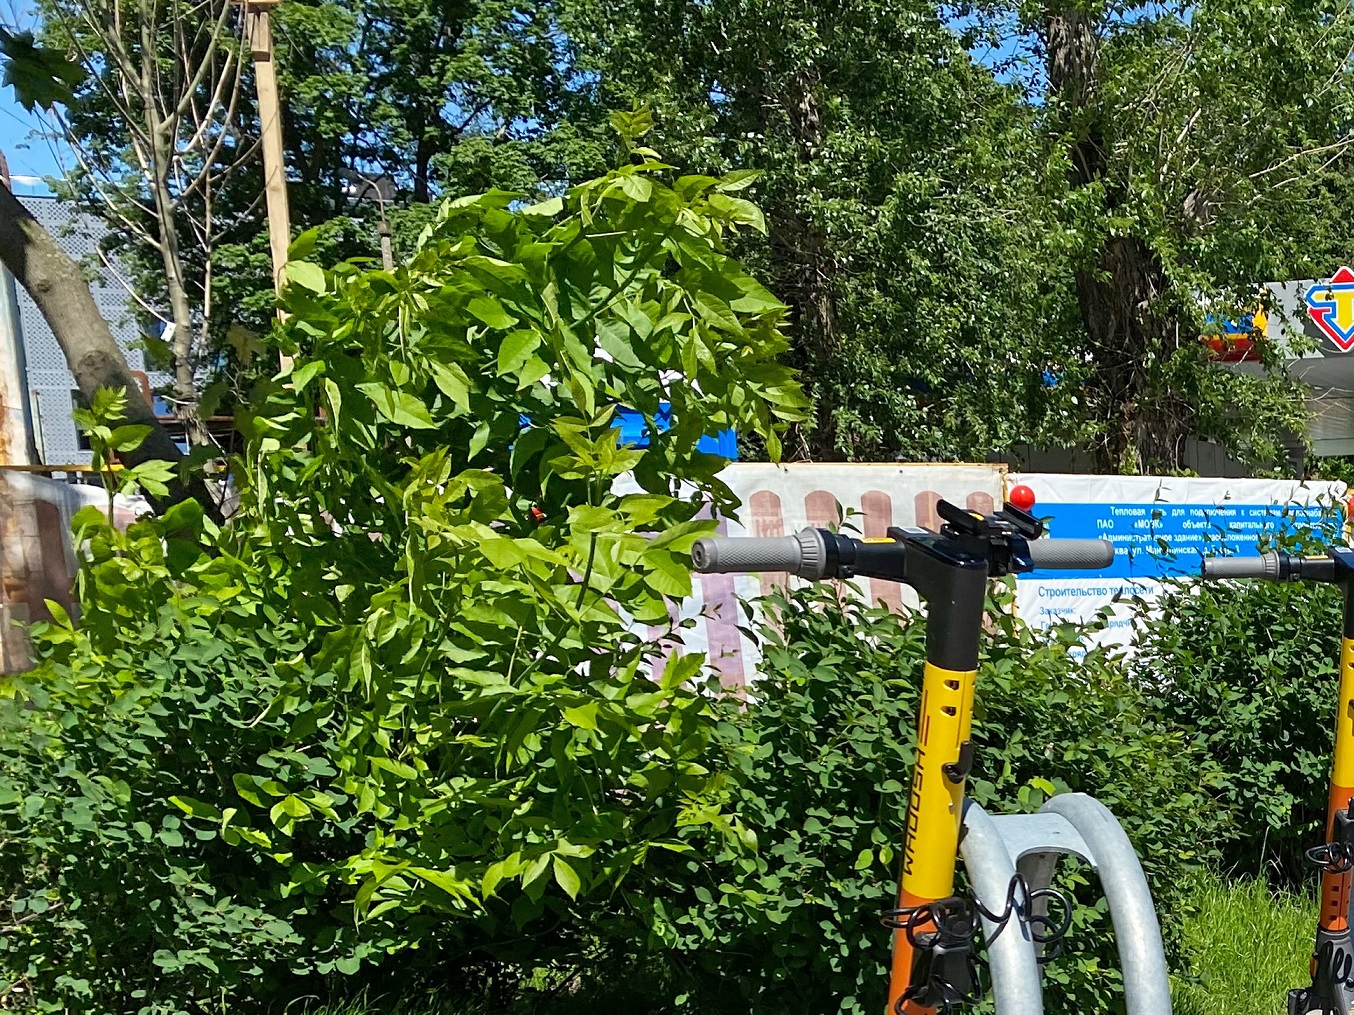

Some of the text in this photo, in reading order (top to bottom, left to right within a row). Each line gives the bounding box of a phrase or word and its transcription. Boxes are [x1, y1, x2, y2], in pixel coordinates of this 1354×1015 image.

[1110, 506, 1146, 516] Тепловая
[1171, 508, 1185, 517] для
[1097, 519, 1114, 529] ПАО
[1038, 586, 1107, 599] Строительство
